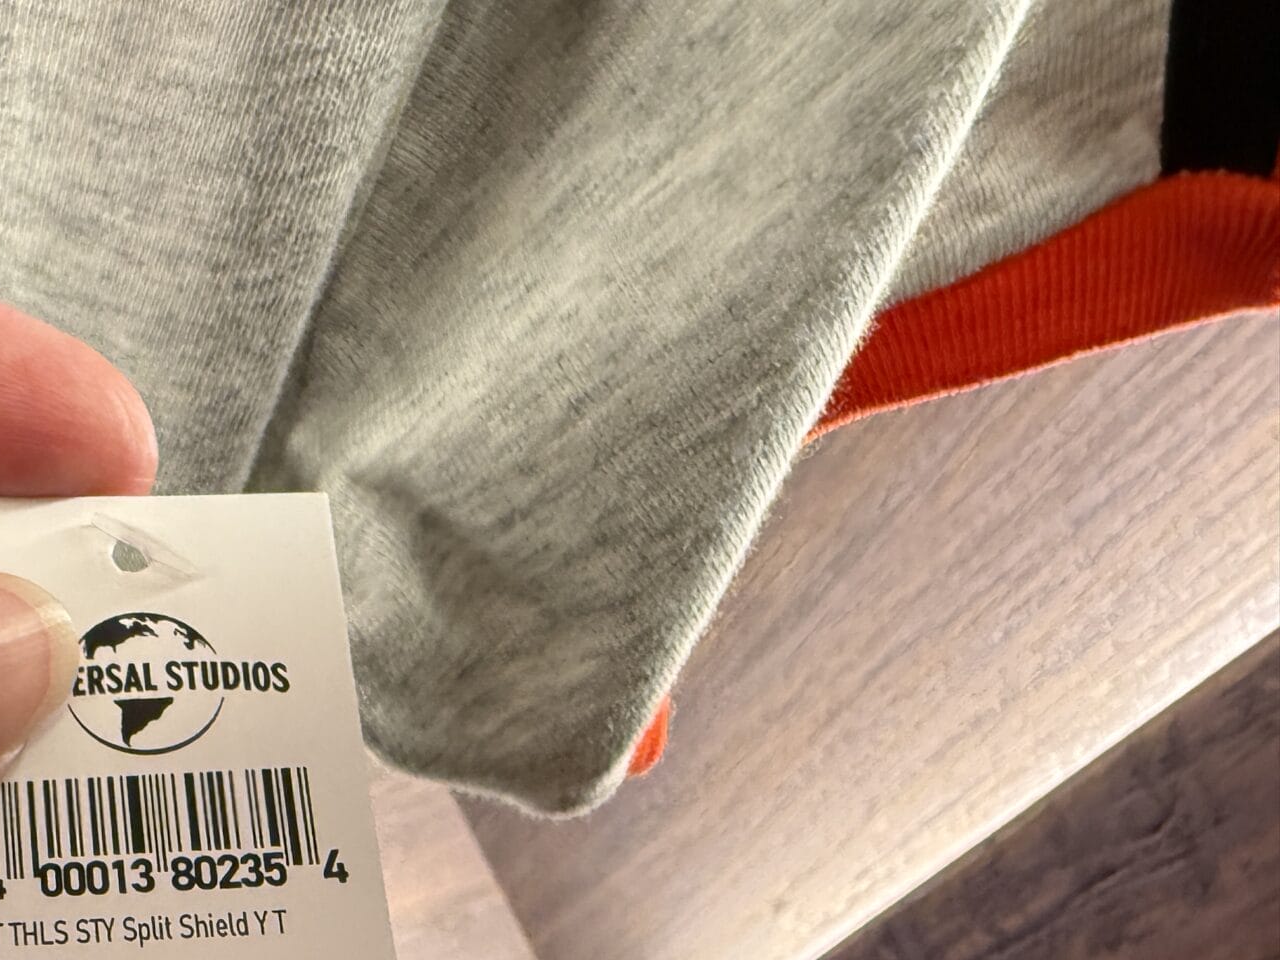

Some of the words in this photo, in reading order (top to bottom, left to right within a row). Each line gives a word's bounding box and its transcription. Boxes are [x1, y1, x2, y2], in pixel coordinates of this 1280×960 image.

[72, 662, 158, 697] ERSAL
[164, 660, 290, 693] STUDIOS
[40, 858, 156, 897] 00013
[171, 853, 288, 891] 80235
[323, 849, 349, 883] 4
[8, 919, 69, 947] THLS
[75, 917, 115, 944] STY
[122, 915, 172, 948] Split
[179, 911, 250, 939] Shield
